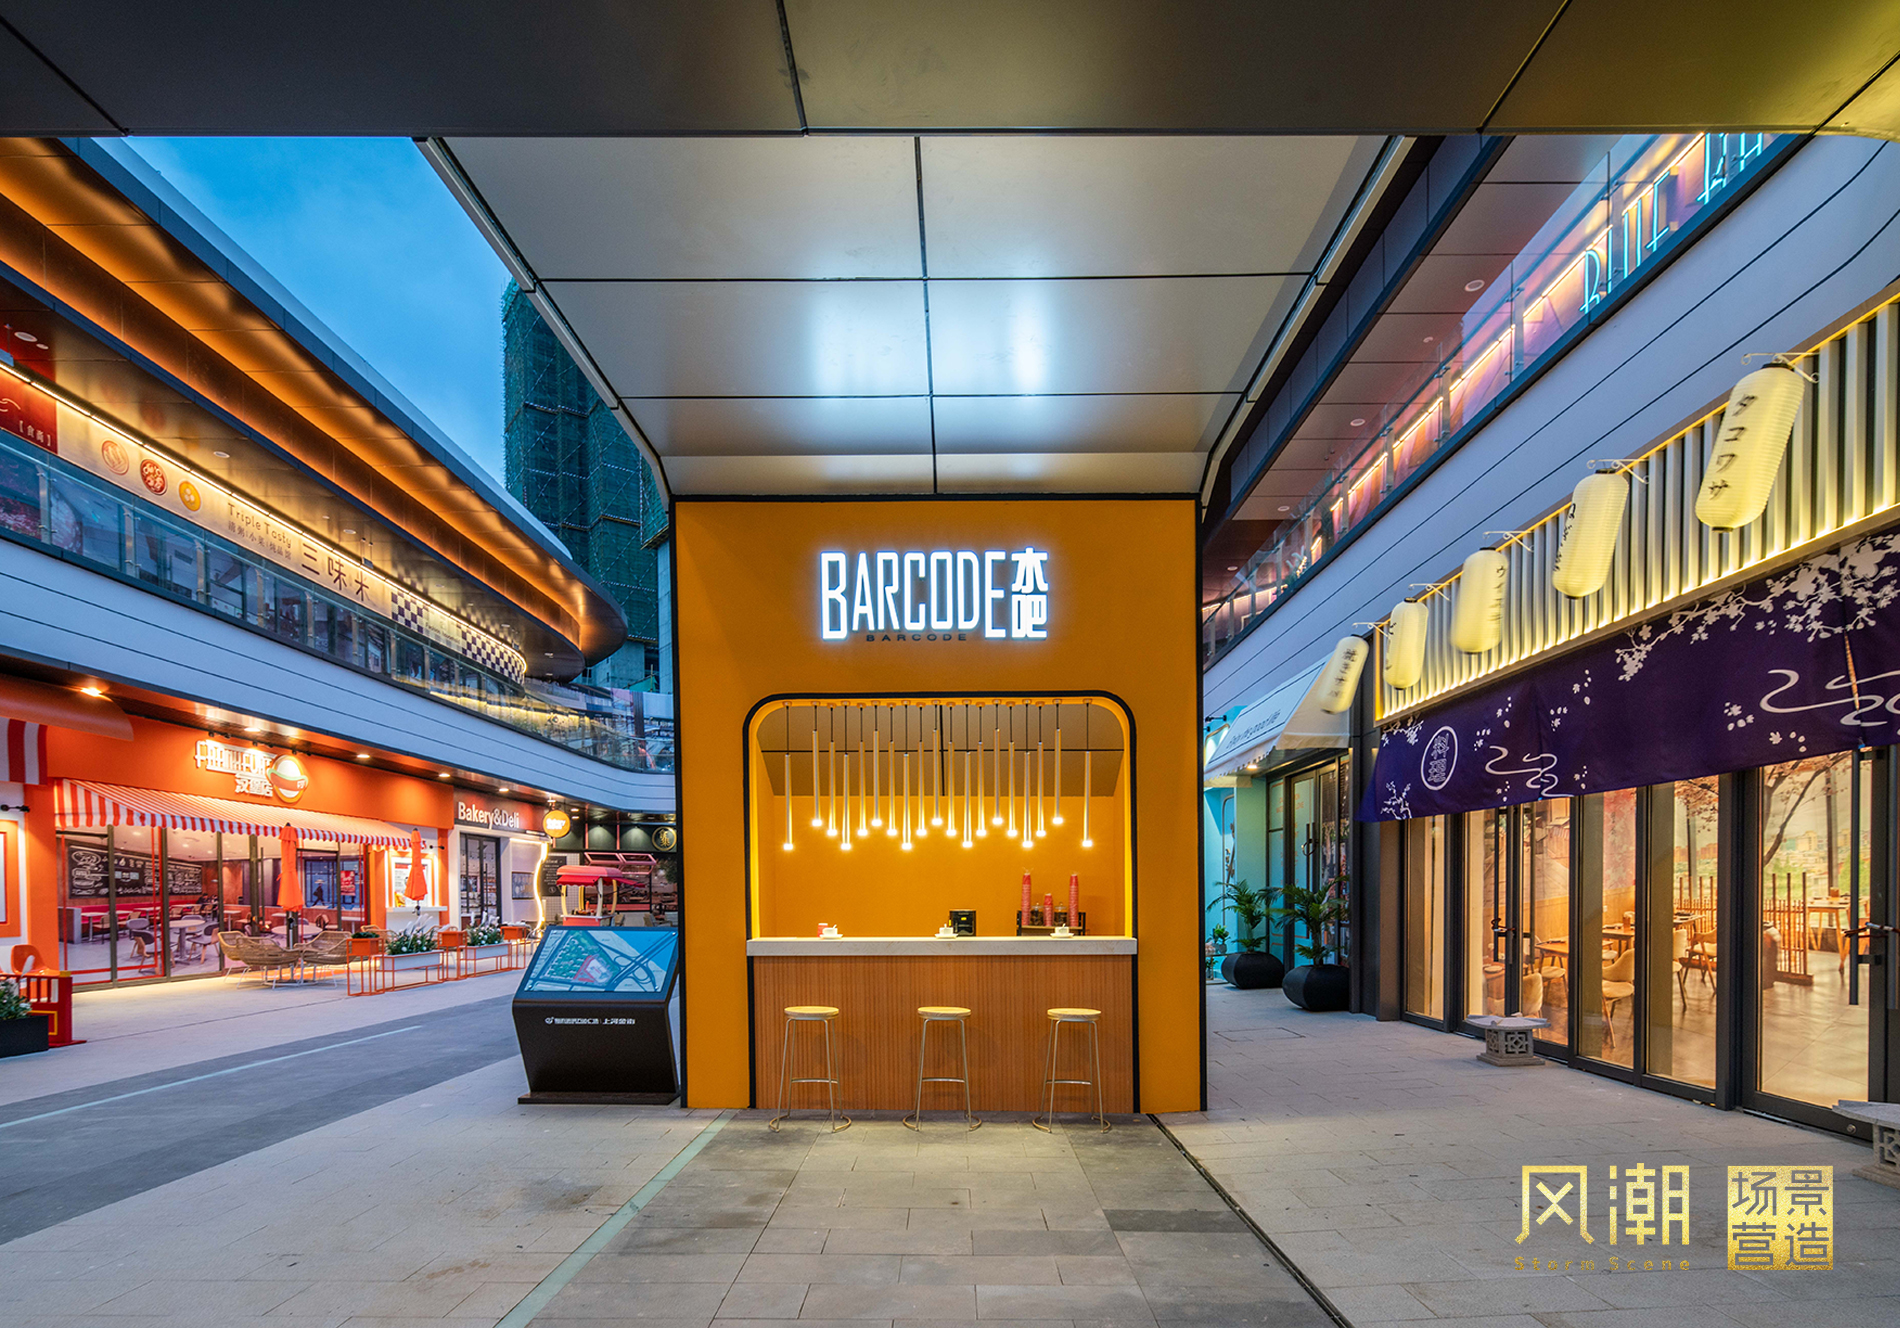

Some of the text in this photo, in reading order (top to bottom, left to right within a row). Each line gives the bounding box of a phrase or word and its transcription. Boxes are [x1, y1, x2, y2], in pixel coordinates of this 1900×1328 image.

[228, 502, 292, 549] Triple Tasty
[820, 550, 1007, 640] BARCODE
[866, 633, 968, 642] BARCODE
